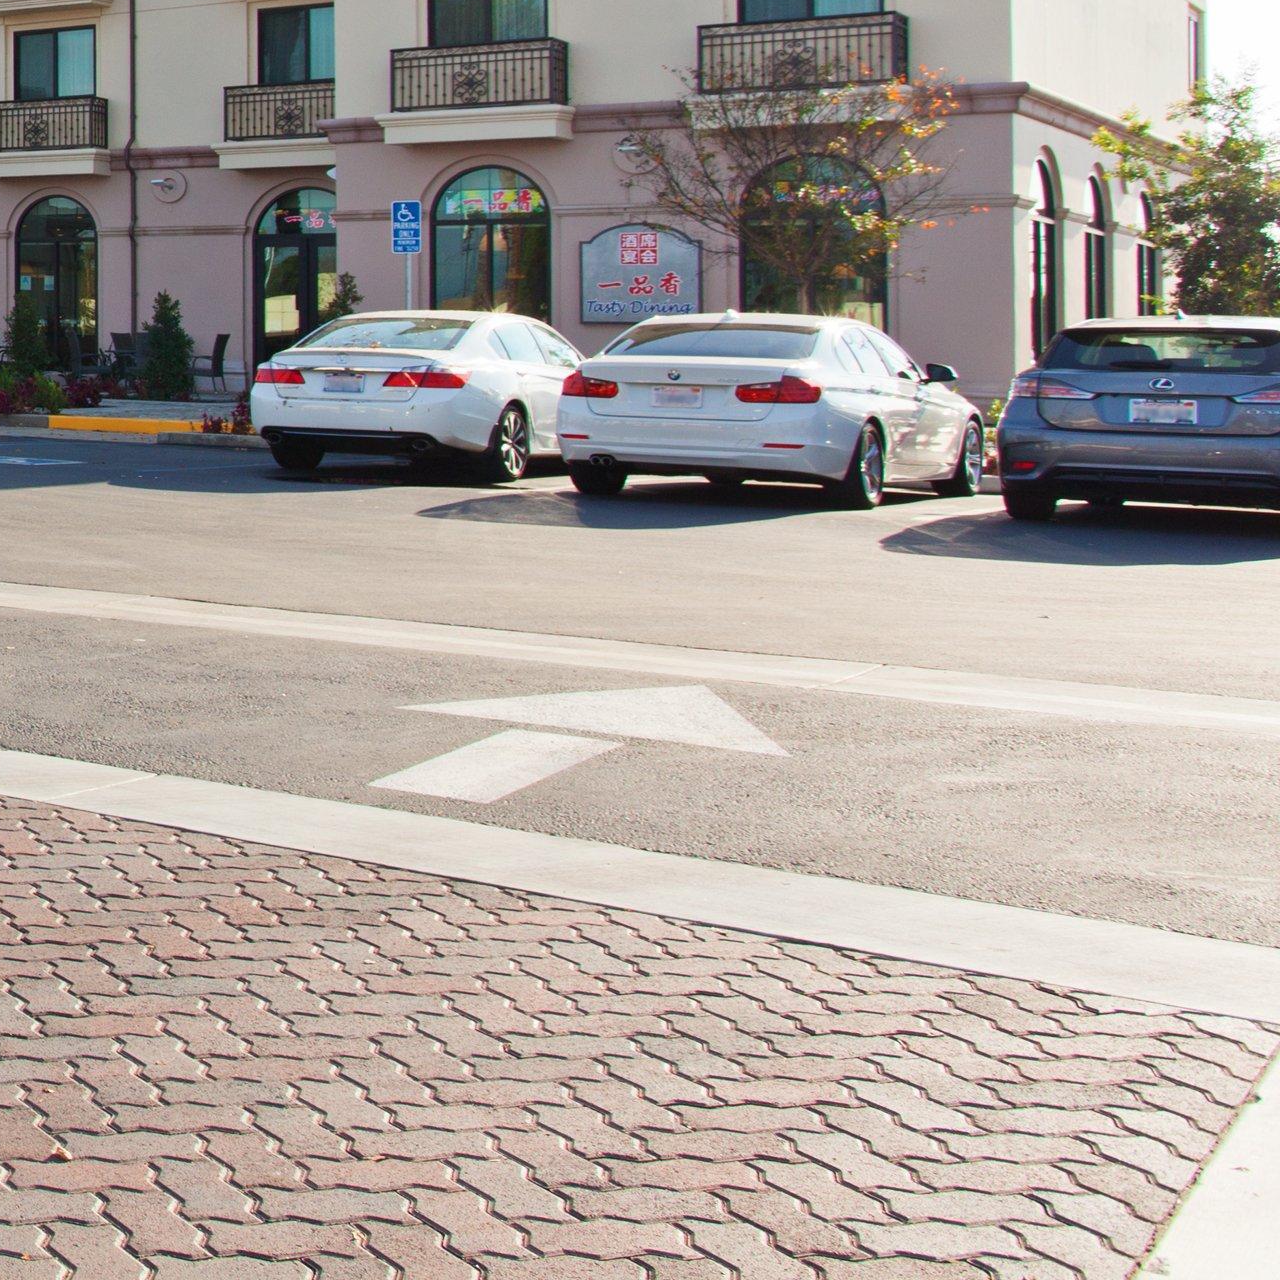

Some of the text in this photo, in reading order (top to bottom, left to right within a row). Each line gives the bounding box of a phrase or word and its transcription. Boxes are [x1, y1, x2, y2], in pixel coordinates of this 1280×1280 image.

[597, 271, 680, 296] 一品香
[587, 299, 693, 316] Tasty Dining
